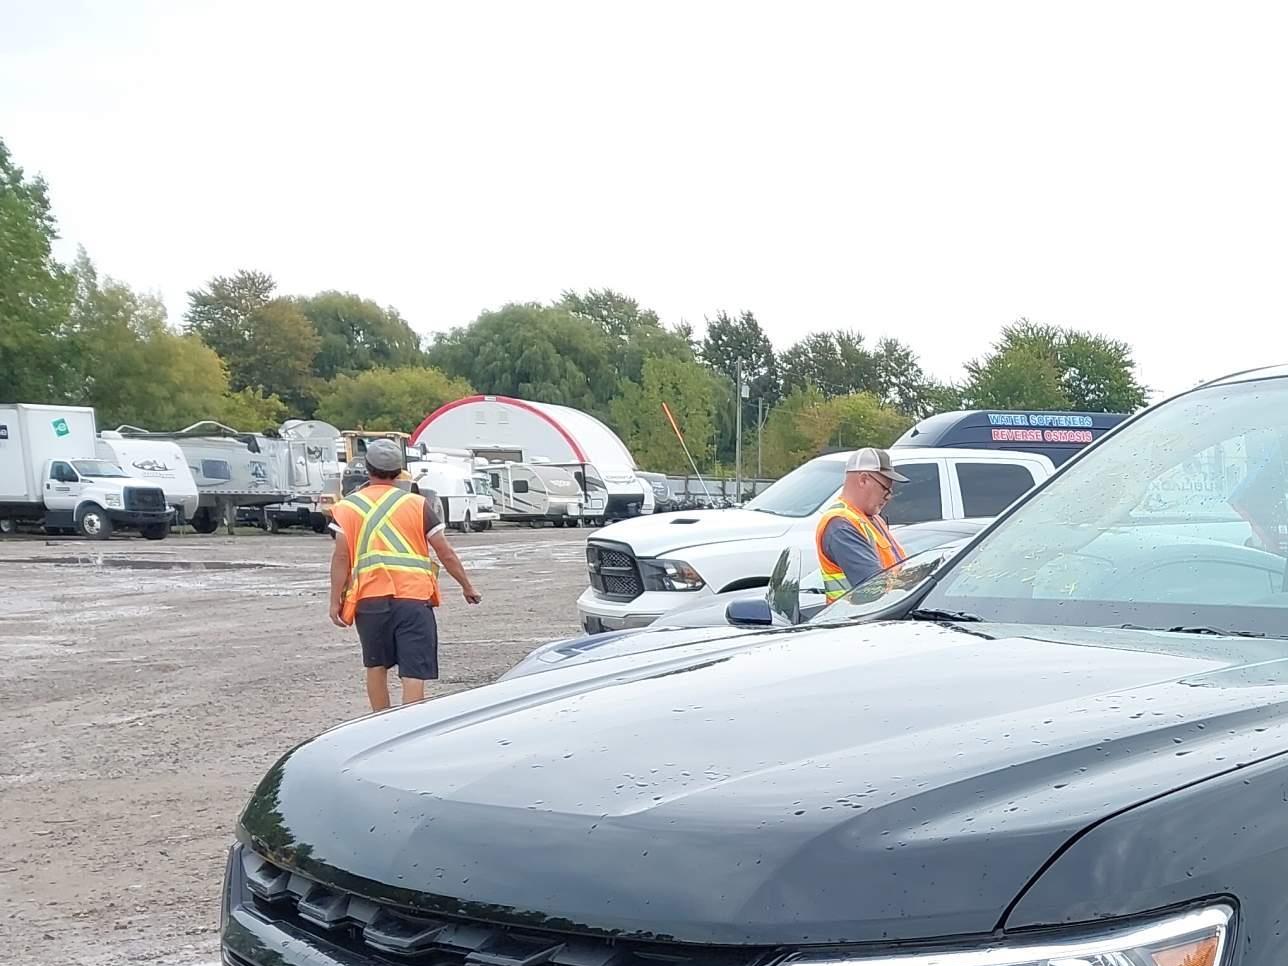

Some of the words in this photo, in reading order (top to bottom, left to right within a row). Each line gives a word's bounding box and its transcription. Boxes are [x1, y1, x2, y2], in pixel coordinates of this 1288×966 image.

[988, 414, 1028, 425] WATER
[1029, 415, 1093, 427] SOFTENERS
[991, 429, 1042, 441] REVERSE
[1044, 430, 1093, 442] OSMOSIS
